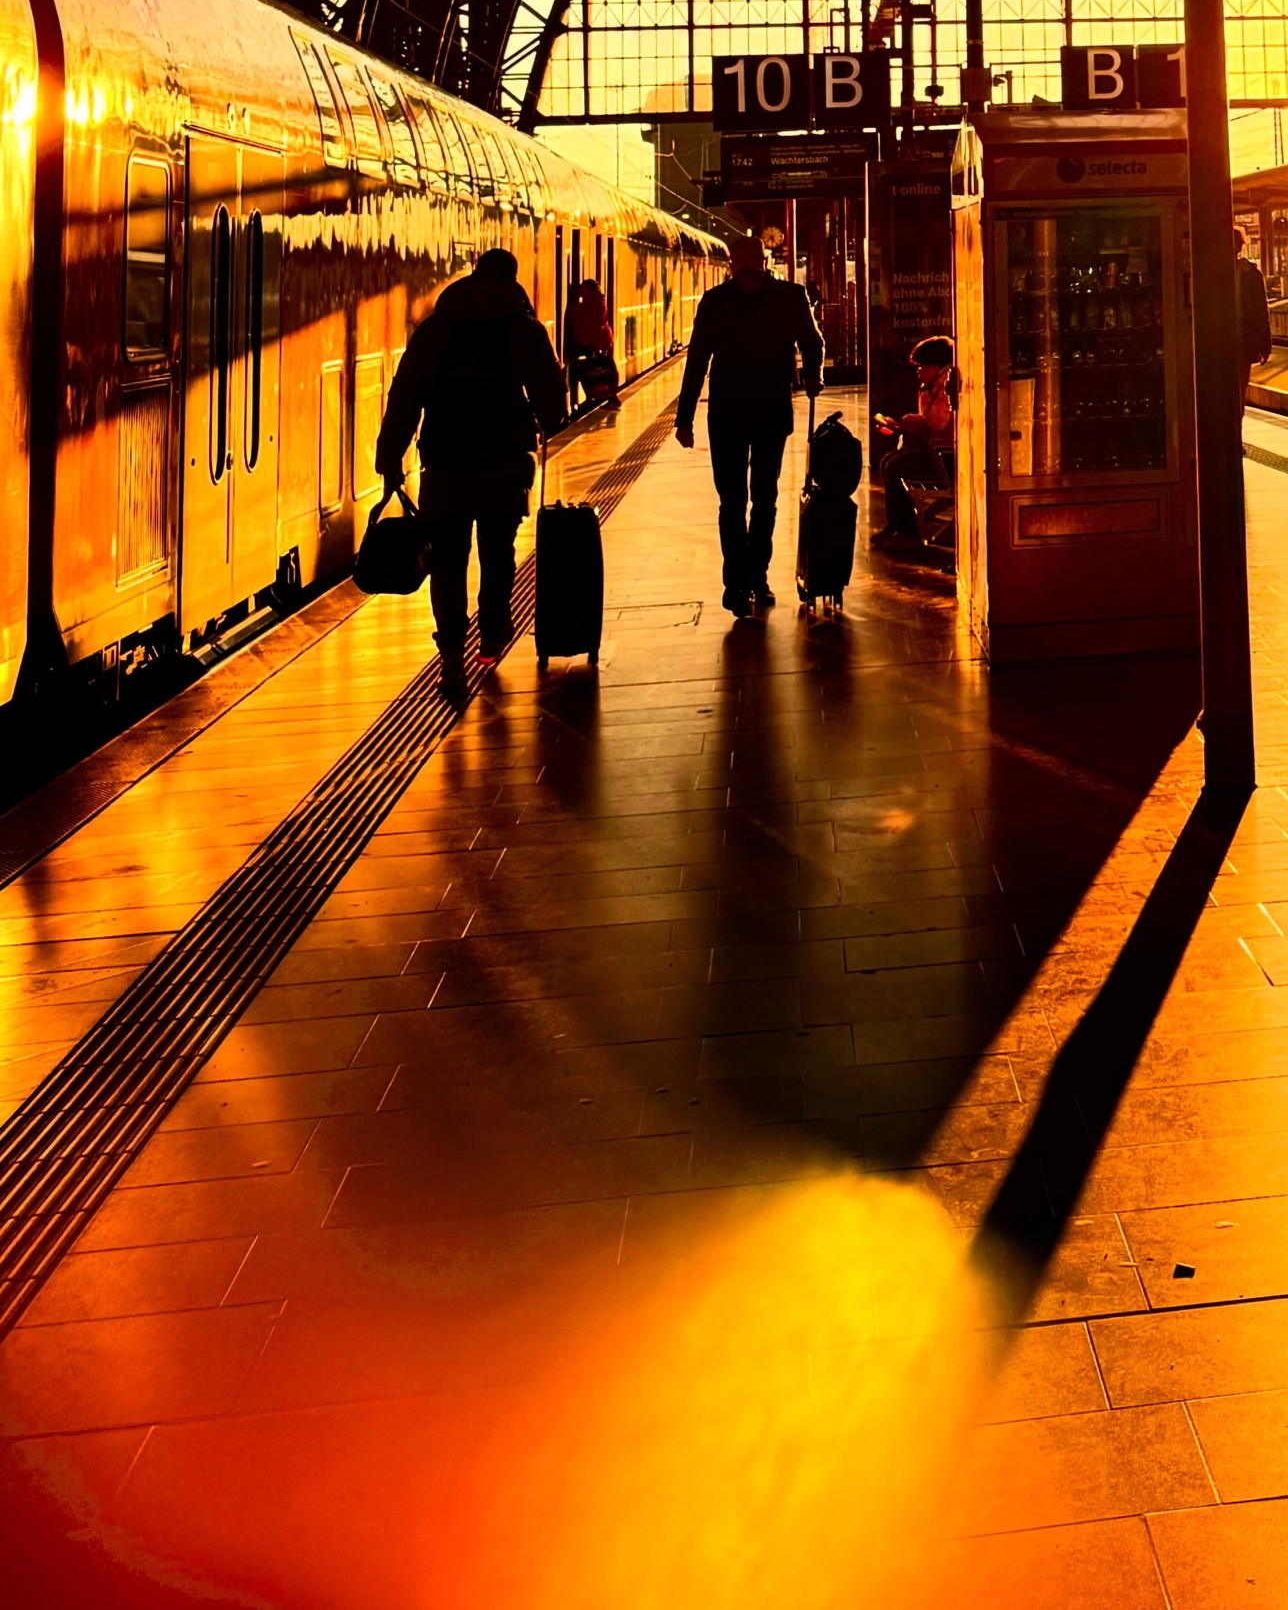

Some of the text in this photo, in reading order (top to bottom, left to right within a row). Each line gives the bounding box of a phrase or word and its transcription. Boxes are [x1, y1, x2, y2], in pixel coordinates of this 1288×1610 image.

[1087, 48, 1124, 100] B
[724, 56, 863, 112] 10 B
[731, 157, 753, 167] 17:42
[1087, 160, 1147, 175] selecta
[892, 182, 942, 196] t-online
[893, 287, 925, 299] ohne
[894, 302, 928, 314] 100%
